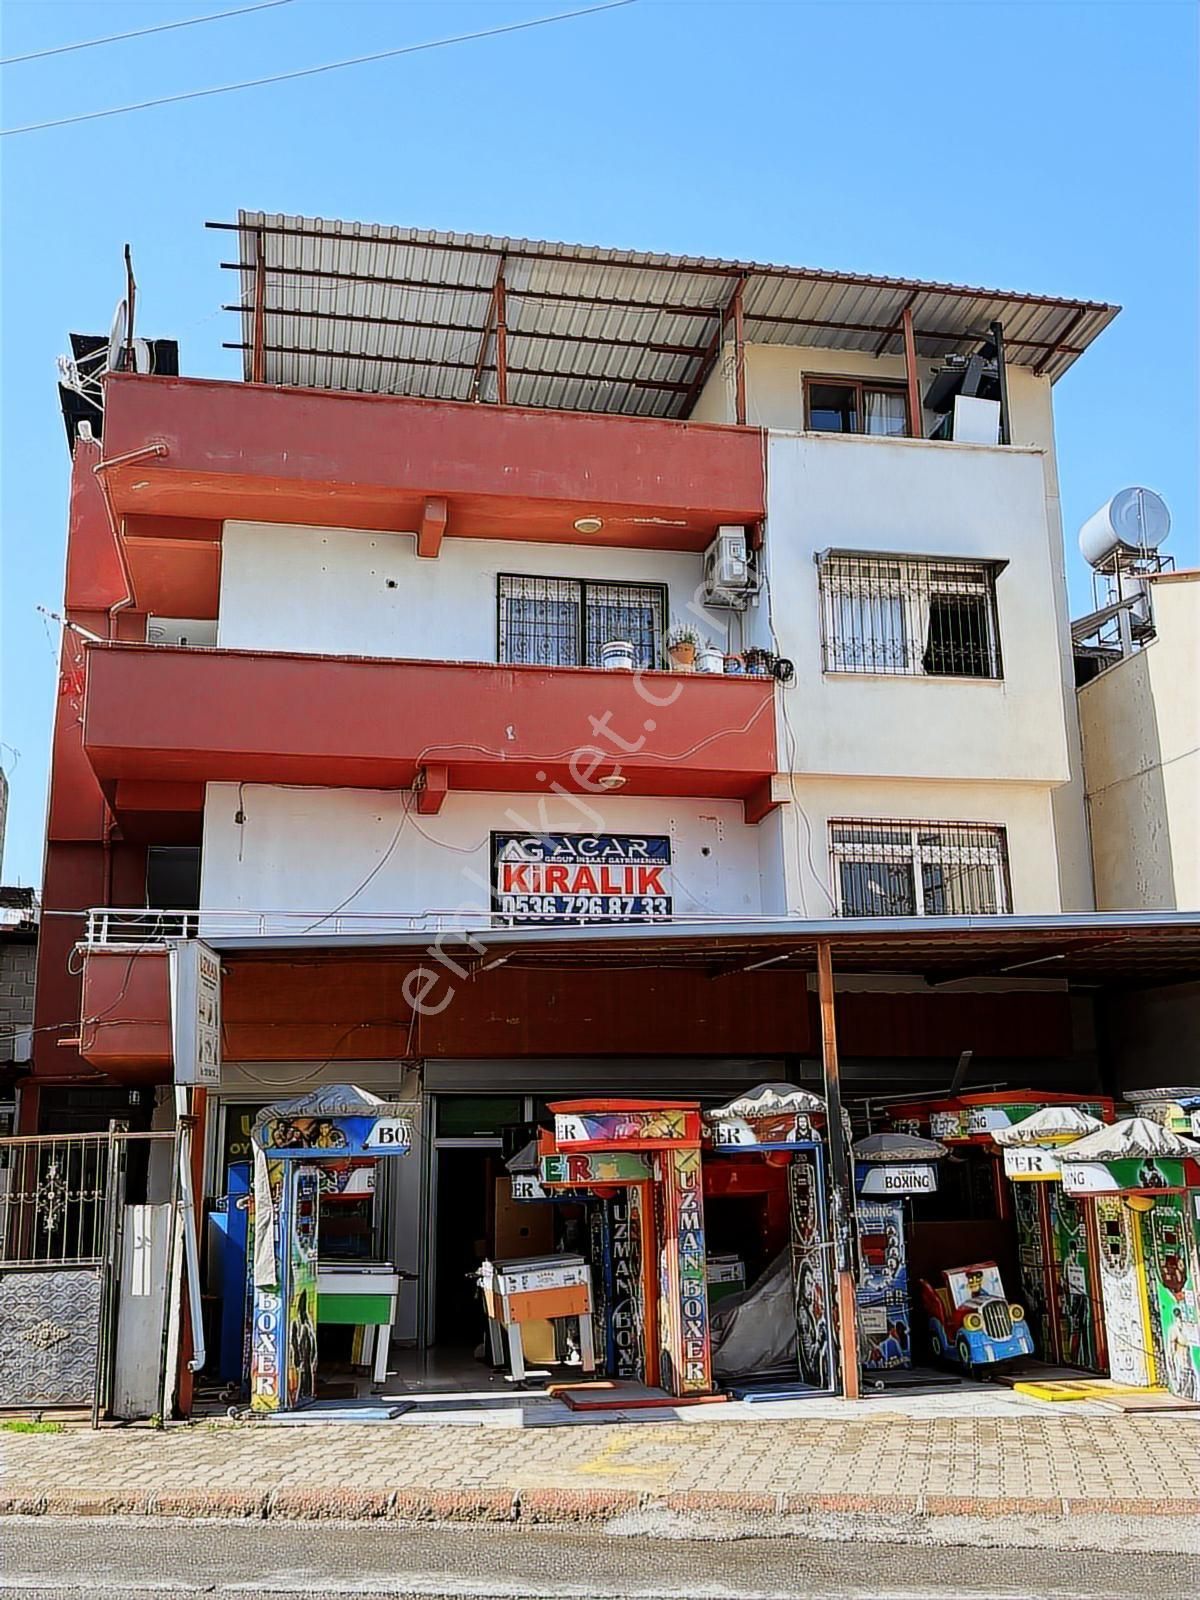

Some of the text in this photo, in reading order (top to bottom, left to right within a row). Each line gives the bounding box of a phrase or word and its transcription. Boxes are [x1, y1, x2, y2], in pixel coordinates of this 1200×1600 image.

[553, 838, 649, 857] ACAR
[545, 857, 574, 865] GROUP
[502, 896, 667, 921] 0536 726 87 33
[545, 1156, 592, 1182] ER
[886, 1175, 930, 1189] BOXING
[679, 1170, 705, 1380] UZMAN BOXER
[256, 1292, 279, 1395] BOXER
